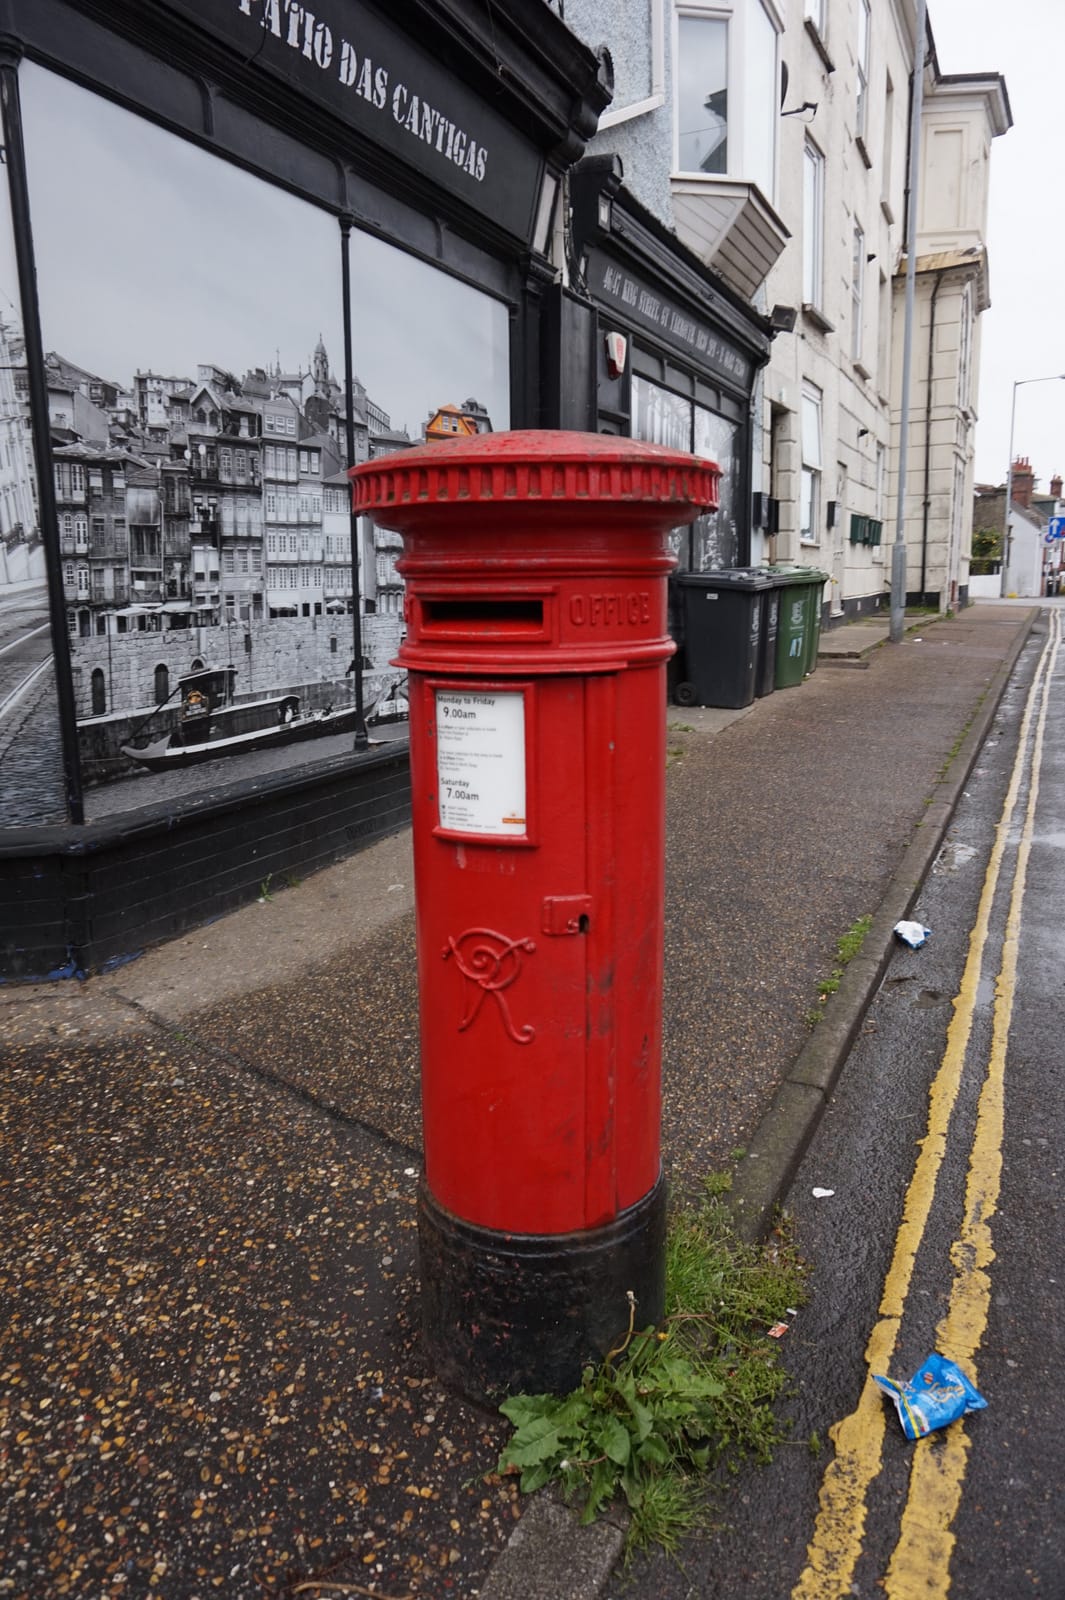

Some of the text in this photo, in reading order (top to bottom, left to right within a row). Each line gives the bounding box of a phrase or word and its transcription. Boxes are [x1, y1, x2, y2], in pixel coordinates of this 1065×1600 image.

[339, 39, 388, 109] DAS
[392, 84, 488, 182] CANTIGAS
[569, 592, 650, 626] OFFICE
[437, 695, 462, 705] Monday
[473, 697, 495, 706] Friday
[443, 706, 476, 718] 9.00am
[441, 777, 470, 788] Saturday
[446, 787, 480, 800] 7.00am
